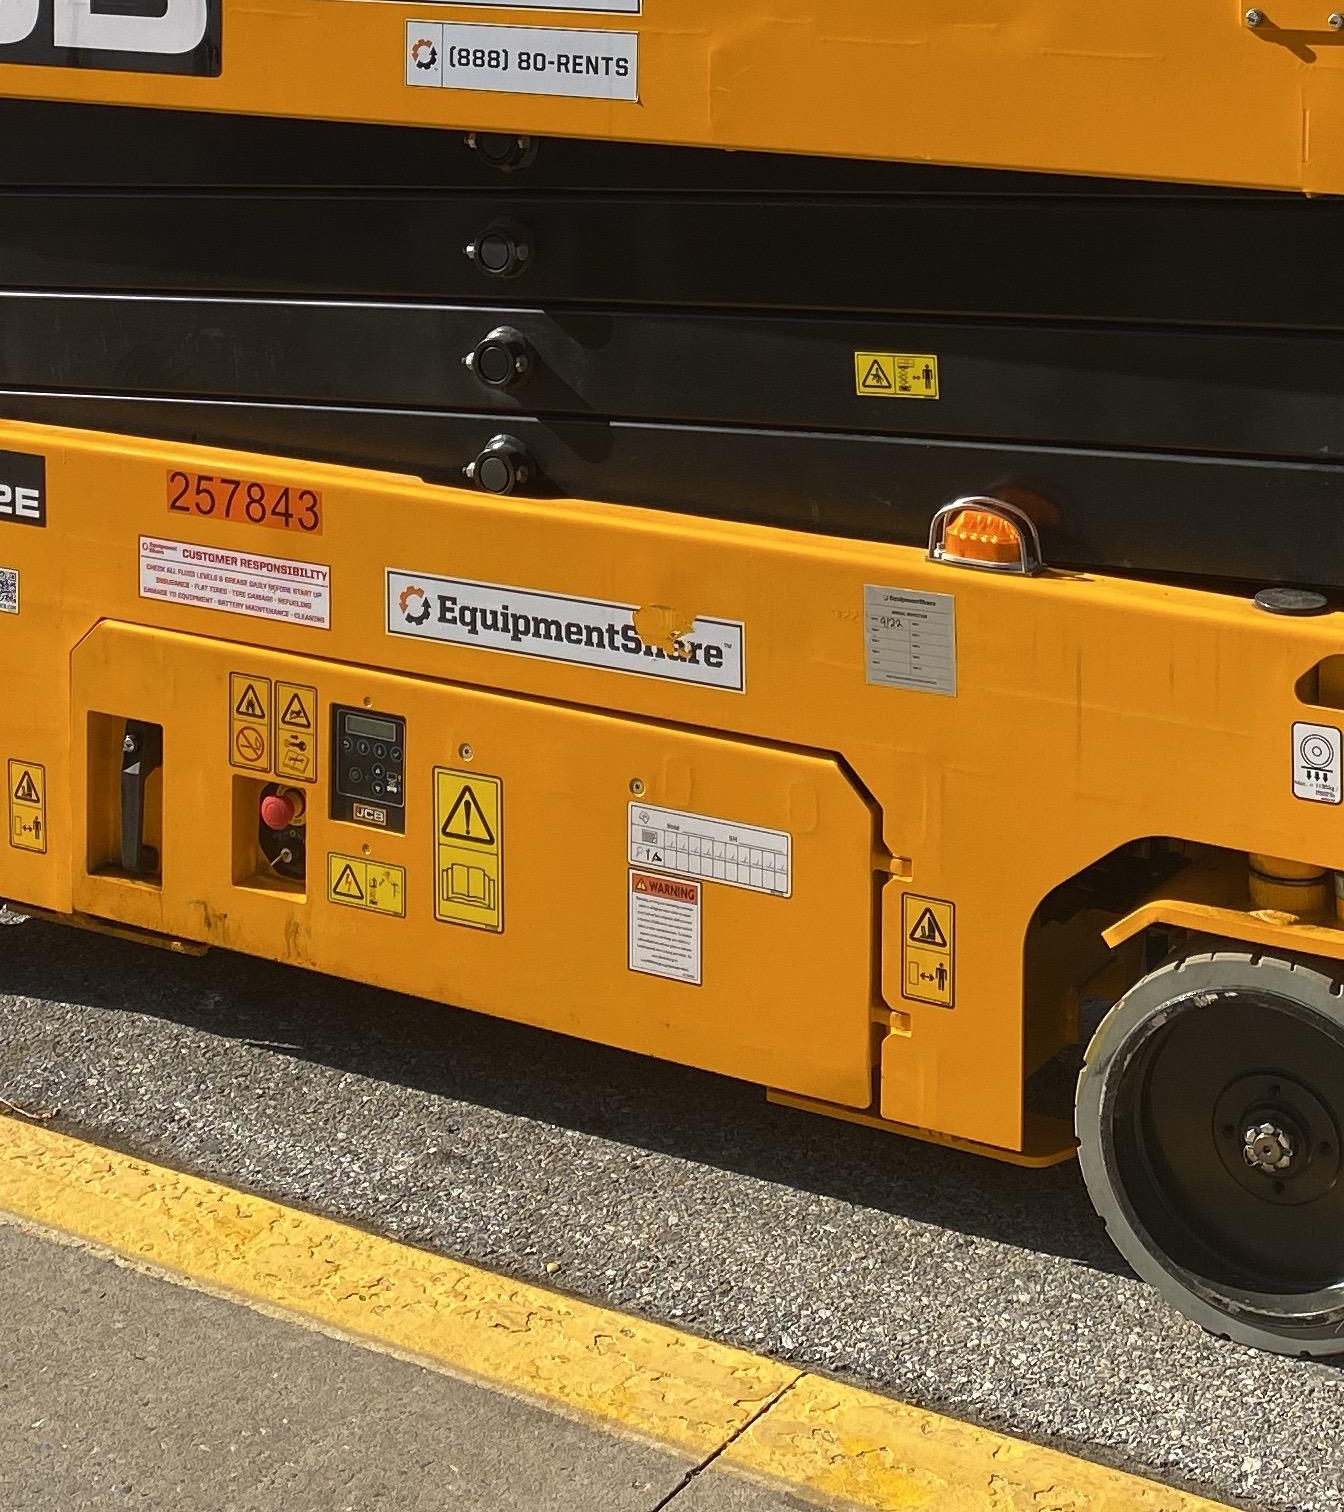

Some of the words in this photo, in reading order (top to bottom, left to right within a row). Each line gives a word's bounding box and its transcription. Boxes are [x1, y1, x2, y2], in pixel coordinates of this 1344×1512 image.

[449, 45, 510, 71] (888)
[517, 51, 629, 77] 80-RENTS
[169, 471, 320, 532] 257843
[166, 566, 178, 575] ALL
[182, 548, 238, 567] CUSTOMER
[240, 557, 328, 582] RESPONSIBILITY
[356, 807, 385, 823] JCB
[648, 879, 695, 901] WARNING
